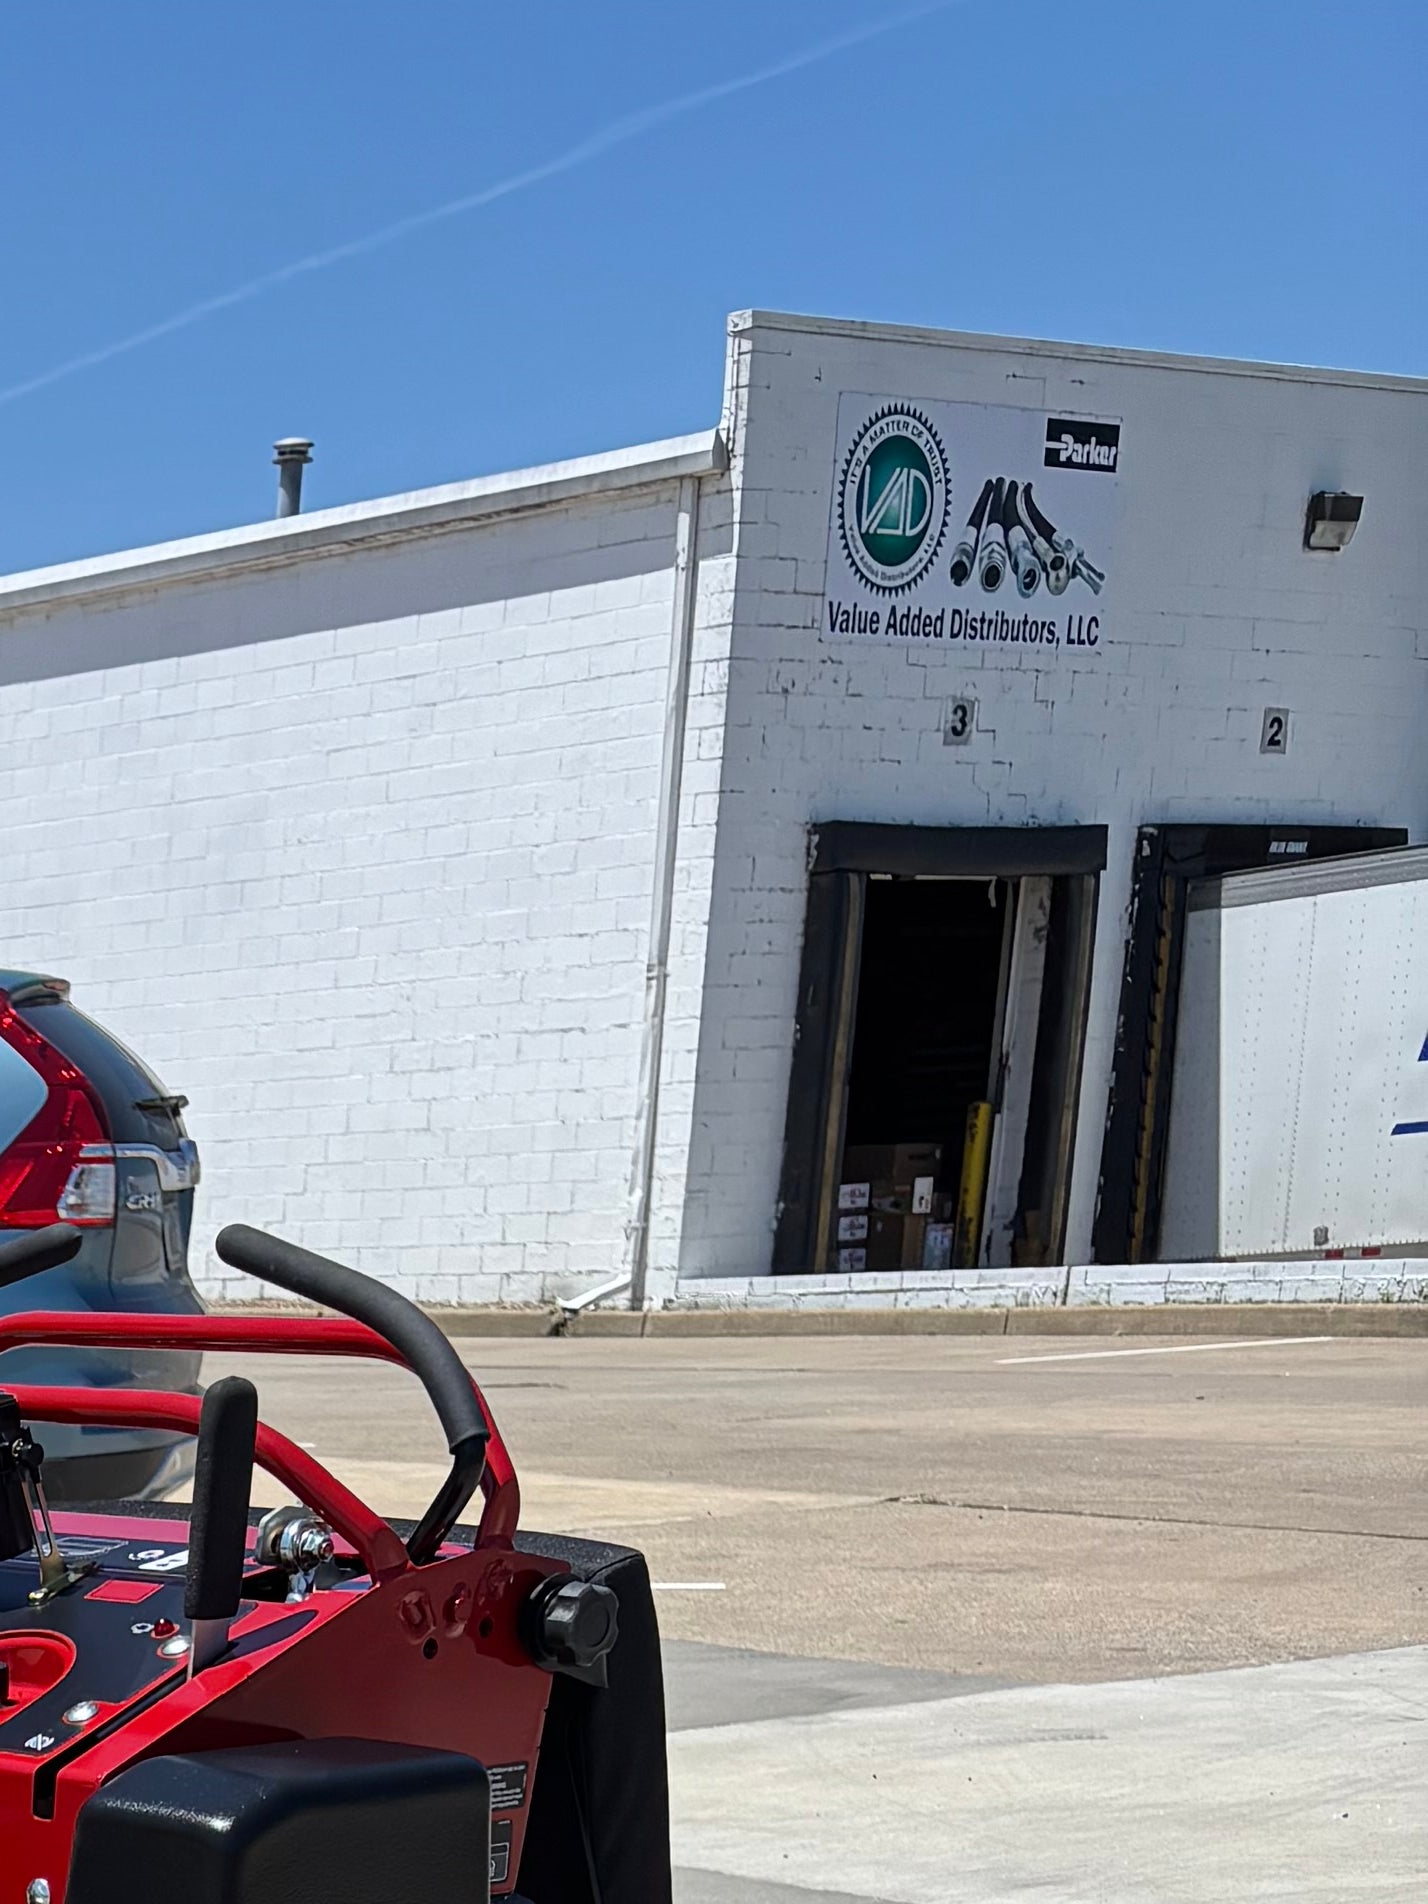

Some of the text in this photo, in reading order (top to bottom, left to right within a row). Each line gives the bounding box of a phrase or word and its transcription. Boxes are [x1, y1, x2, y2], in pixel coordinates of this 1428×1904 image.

[1058, 433, 1117, 466] Parker
[860, 464, 933, 536] VAD
[828, 601, 1100, 649] Value Added Distributors, LLC
[951, 704, 968, 736] 3
[1267, 716, 1285, 747] 2
